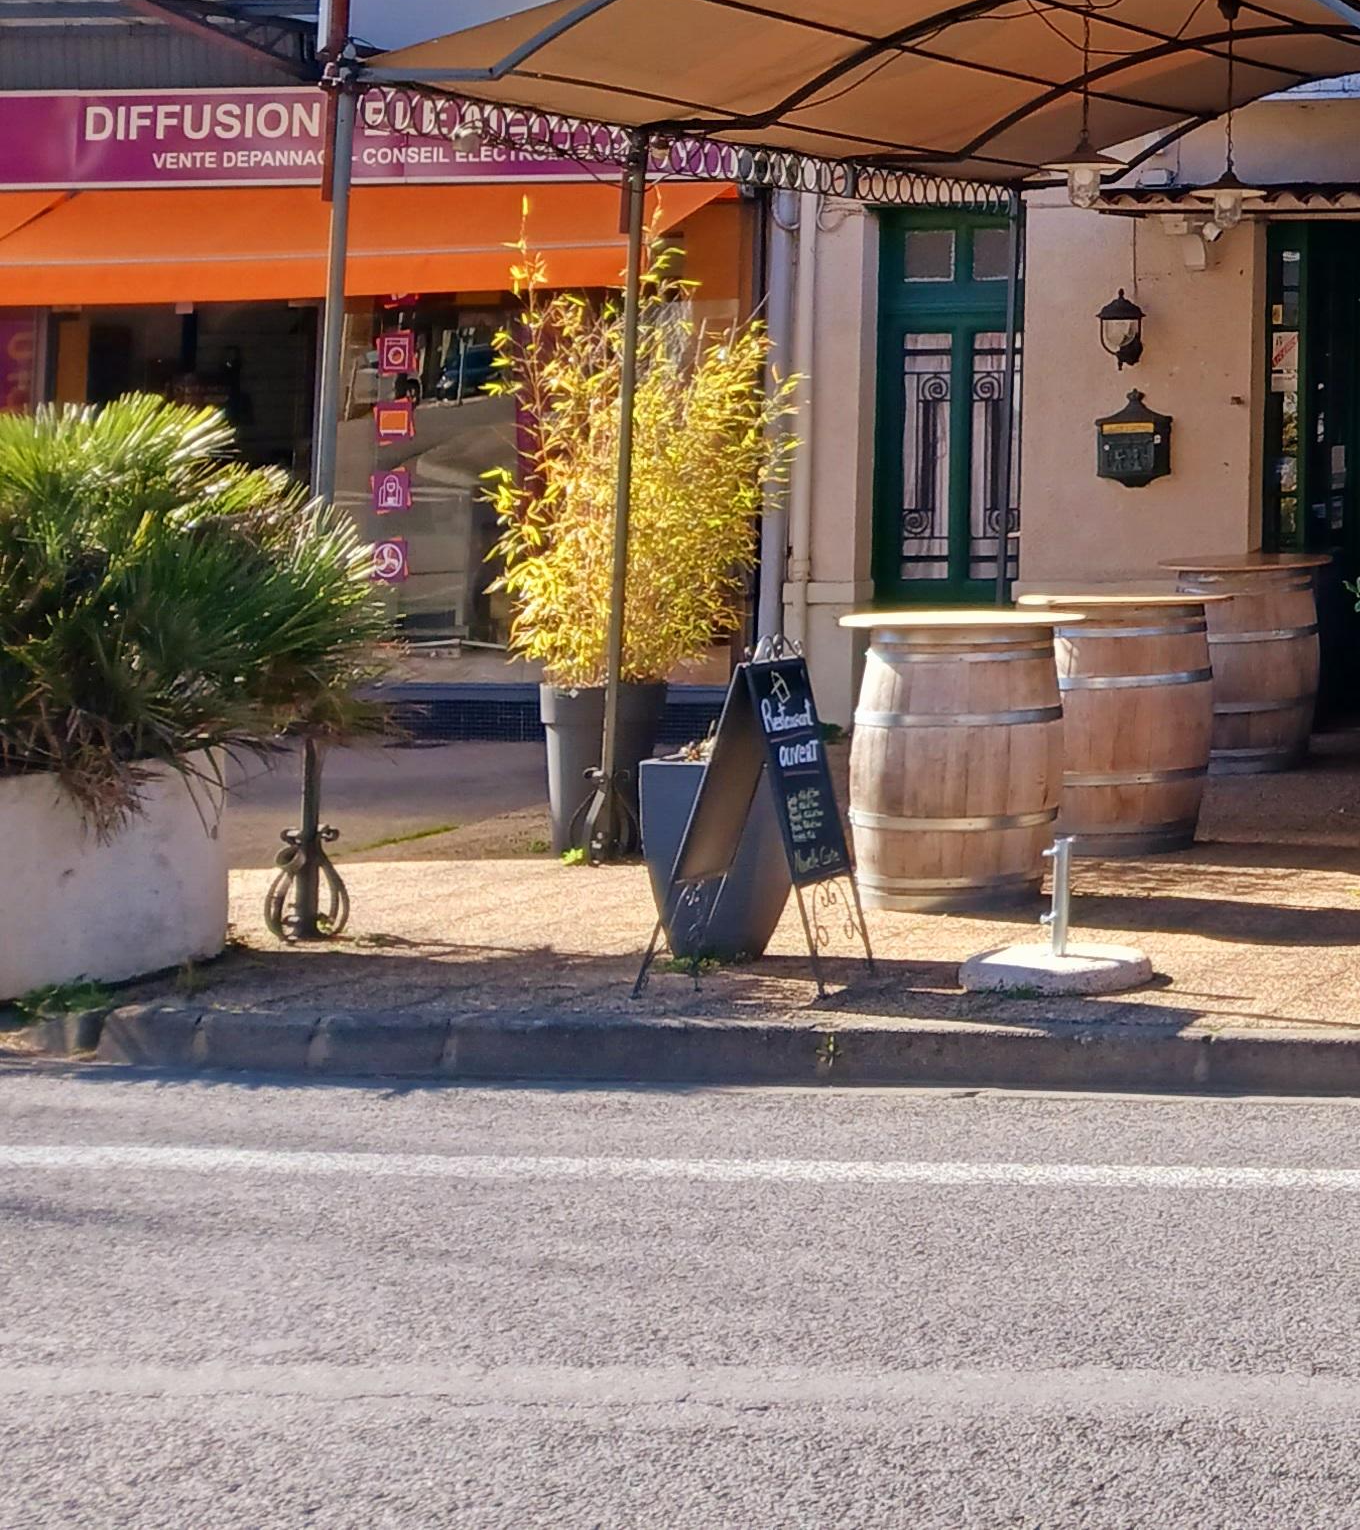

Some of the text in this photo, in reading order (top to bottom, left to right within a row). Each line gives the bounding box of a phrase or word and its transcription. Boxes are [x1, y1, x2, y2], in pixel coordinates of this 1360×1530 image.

[85, 102, 320, 141] DIFFUSION
[153, 151, 217, 169] VENTE
[223, 149, 325, 168] DEPANNA
[362, 146, 451, 165] CONSEIL
